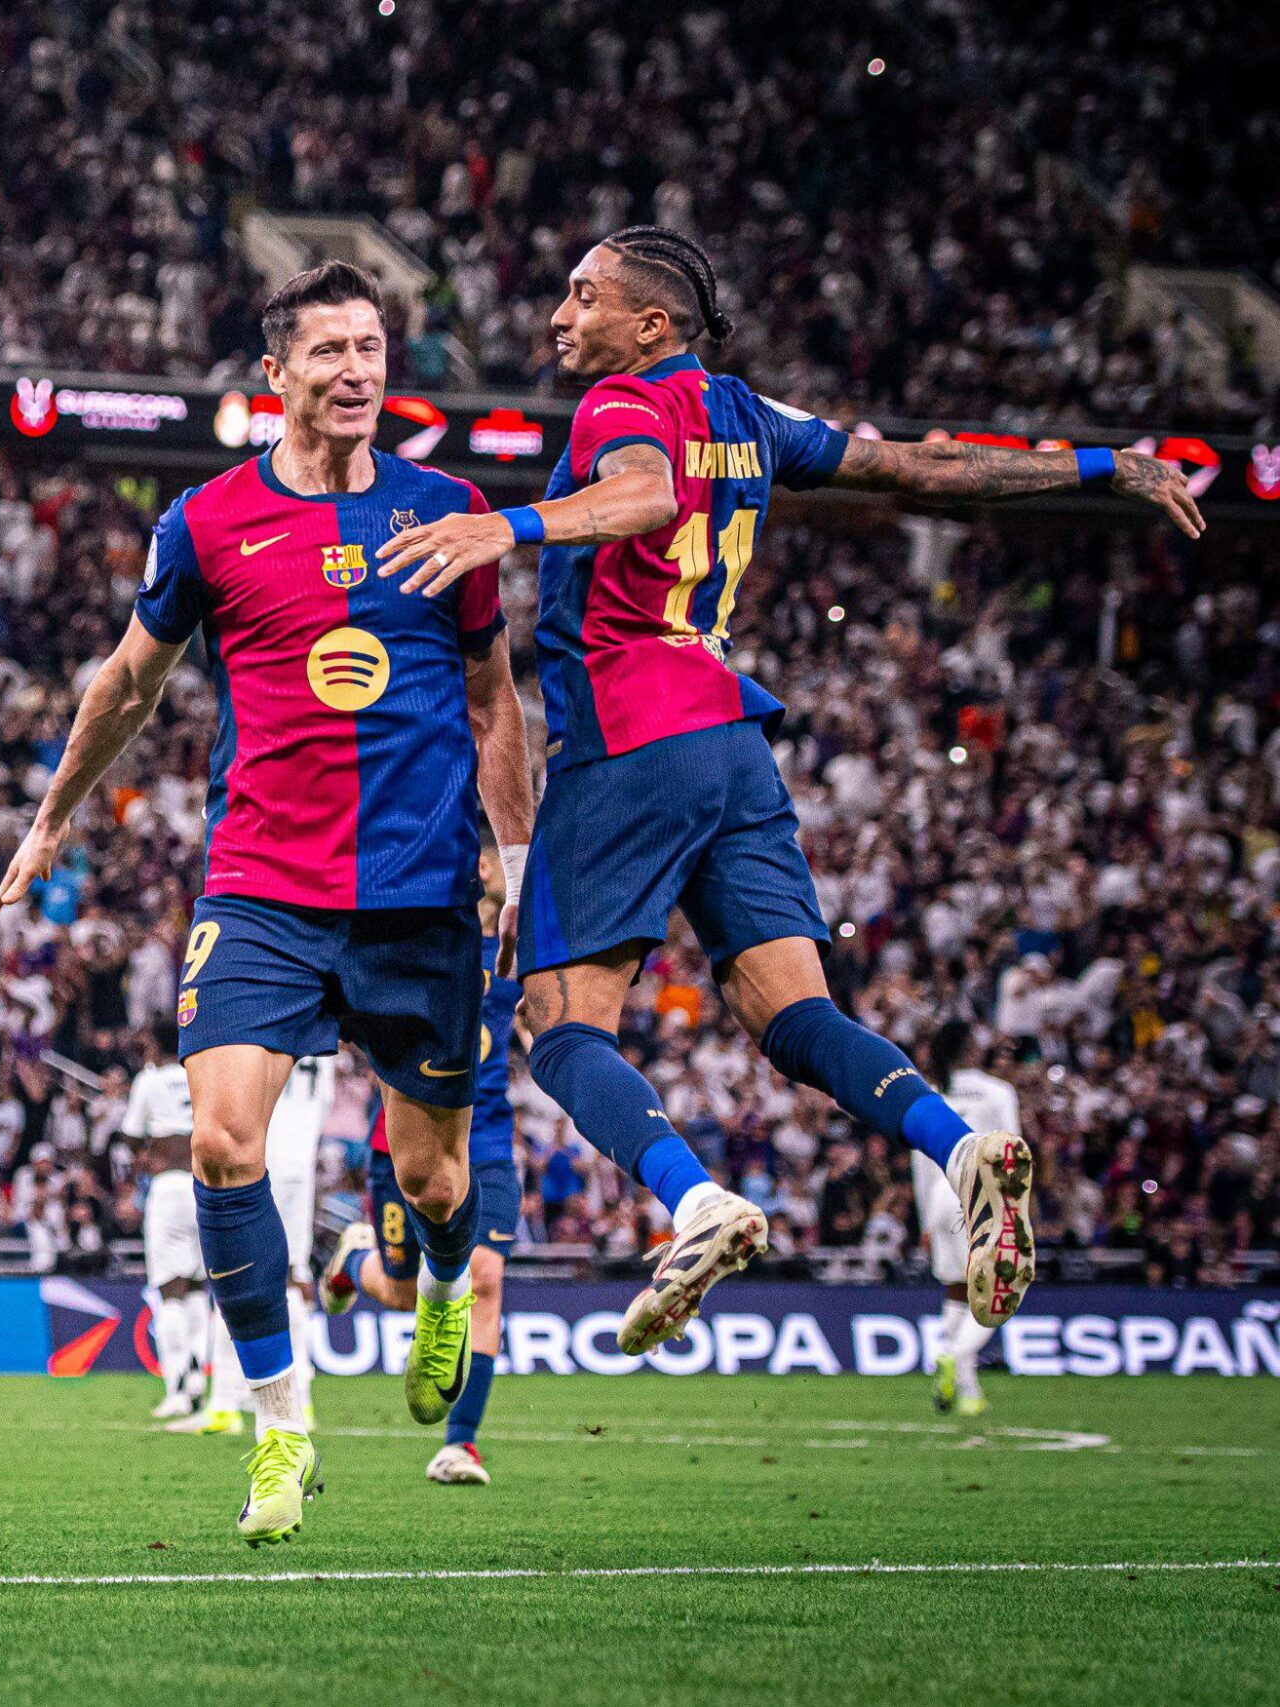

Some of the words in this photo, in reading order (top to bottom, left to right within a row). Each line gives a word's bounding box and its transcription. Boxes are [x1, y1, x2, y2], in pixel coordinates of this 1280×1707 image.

[663, 509, 758, 639] 11
[182, 921, 221, 985] 9
[383, 1202, 405, 1245] 8
